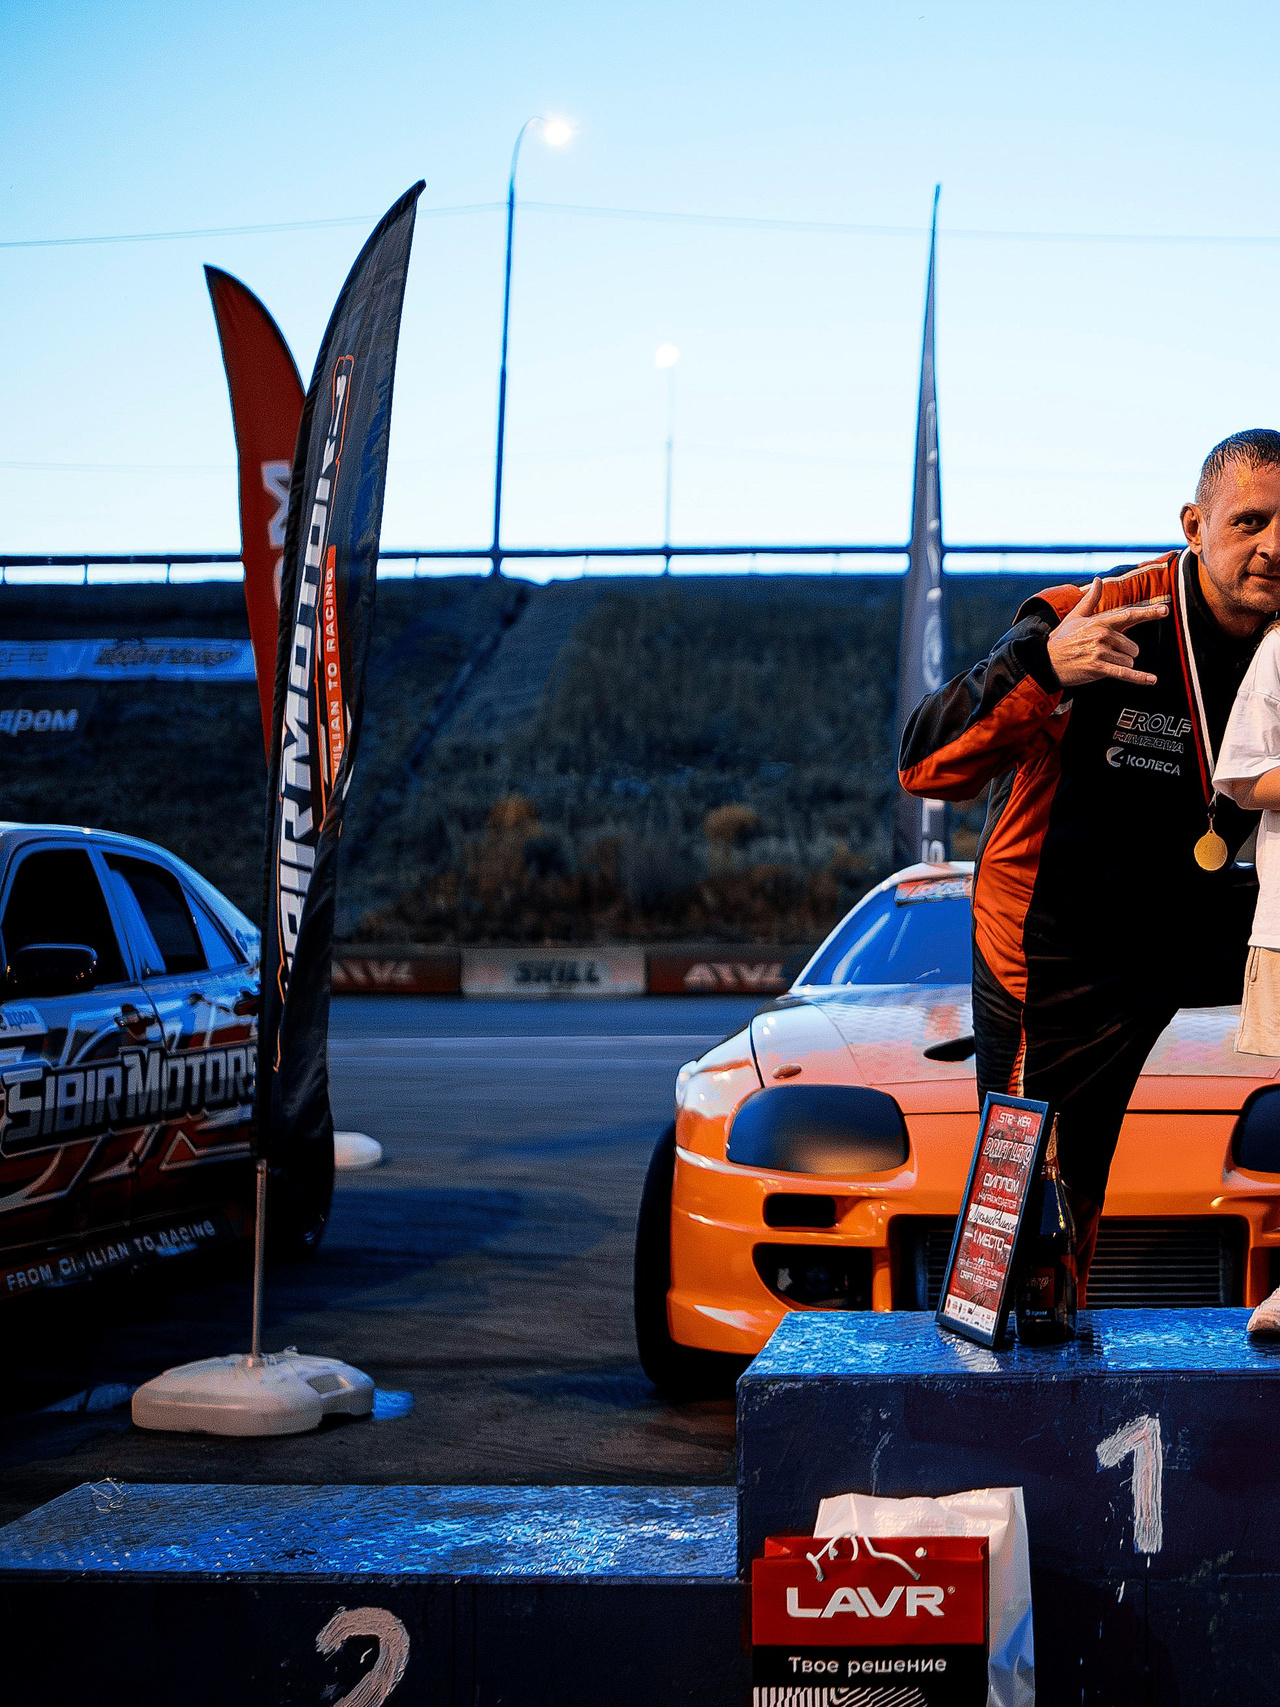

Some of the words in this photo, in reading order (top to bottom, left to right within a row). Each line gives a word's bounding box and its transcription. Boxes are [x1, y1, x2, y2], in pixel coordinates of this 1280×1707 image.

[325, 567, 336, 652] RACING
[327, 662, 338, 691] TO
[1126, 755, 1180, 776] КОЛЕСА
[983, 1136, 1013, 1160] DRIFT
[6, 1264, 53, 1291] FROM
[134, 1234, 154, 1252] TO
[159, 1220, 216, 1248] RACING
[978, 1230, 1005, 1252] МЕСТО
[1096, 1414, 1163, 1554] 1
[786, 1586, 945, 1618] LAVR
[315, 1606, 411, 1707] 2
[788, 1656, 839, 1673] Твое
[847, 1657, 948, 1677] решение
